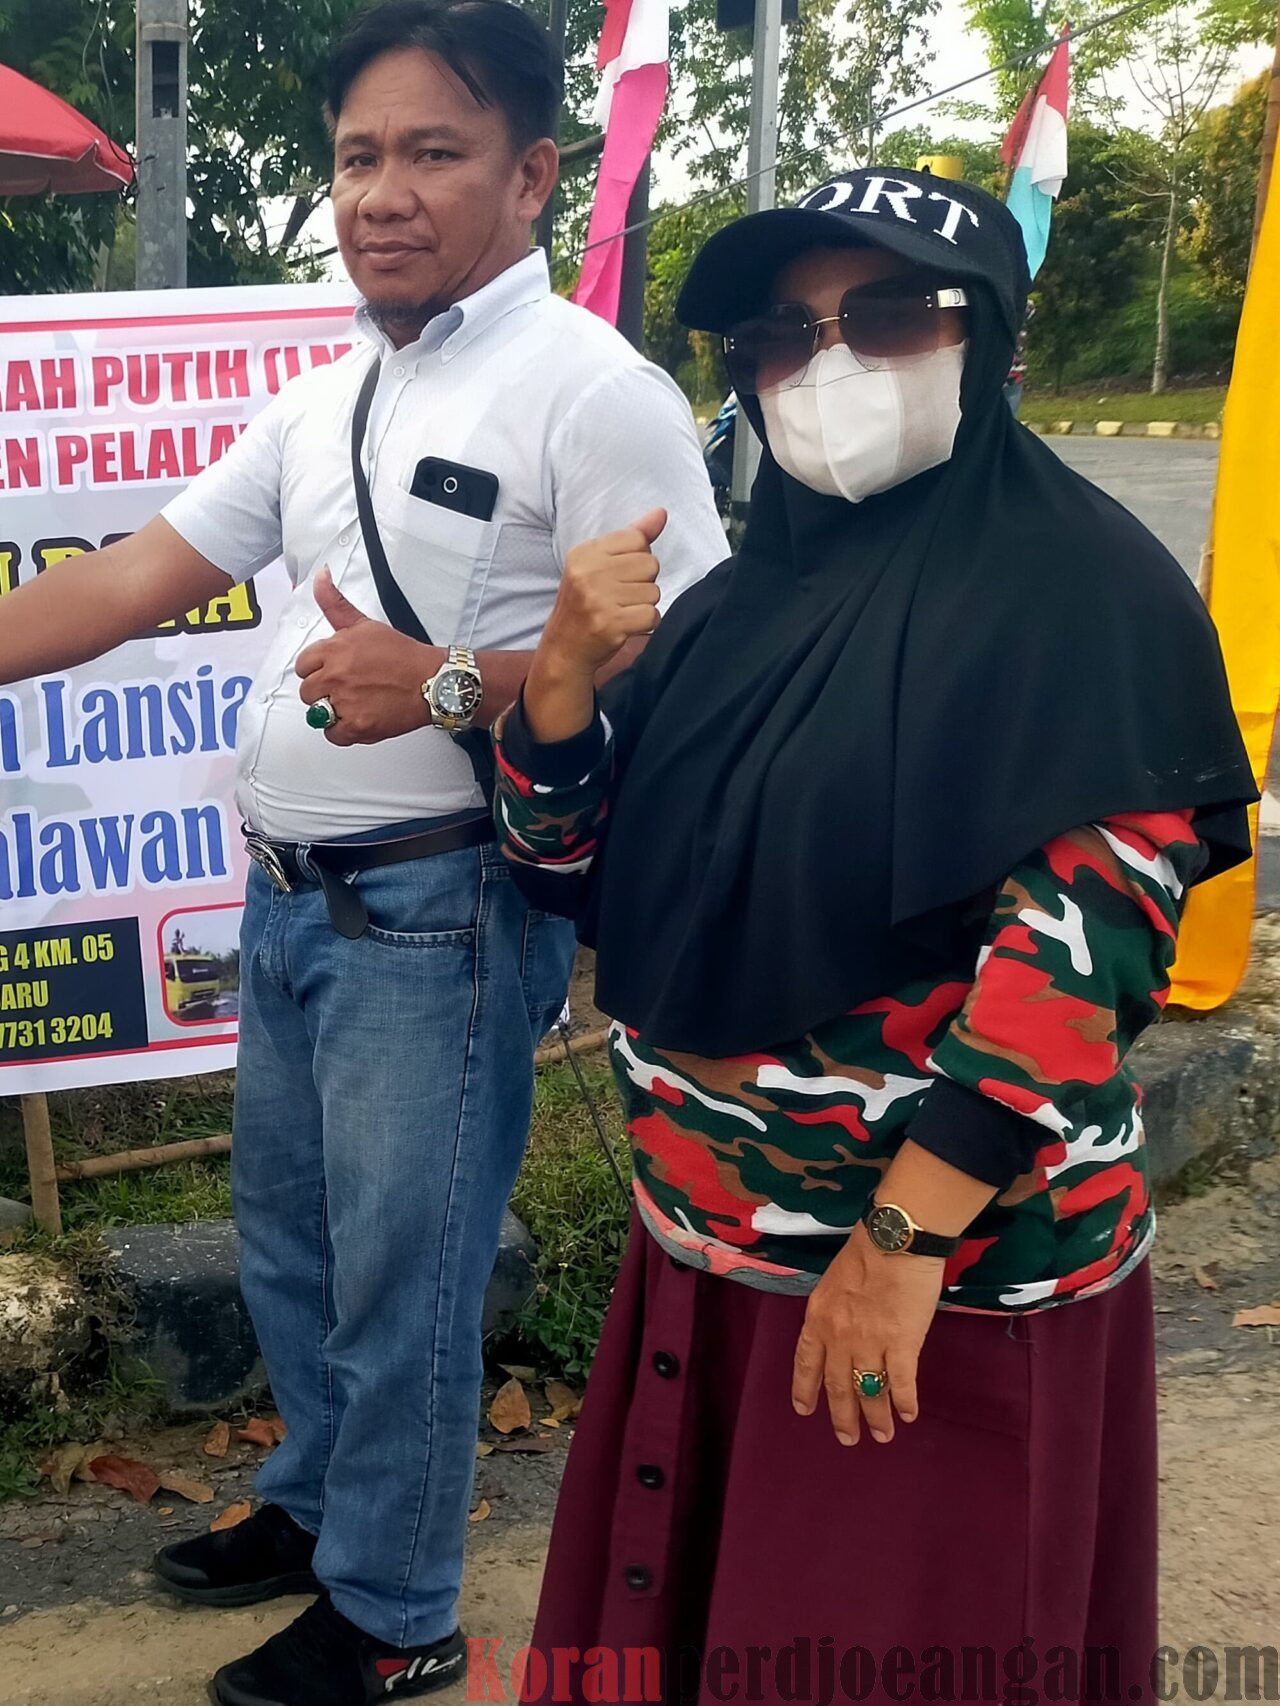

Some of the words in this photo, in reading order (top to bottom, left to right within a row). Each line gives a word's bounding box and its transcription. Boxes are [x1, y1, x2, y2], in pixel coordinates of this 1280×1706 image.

[91, 349, 250, 407] PUTIH
[56, 423, 248, 486] PELALA
[41, 665, 254, 768] Lansia
[14, 943, 30, 970] 4
[34, 938, 78, 968] KM.
[82, 933, 115, 963] 05
[50, 1012, 113, 1044] 3204
